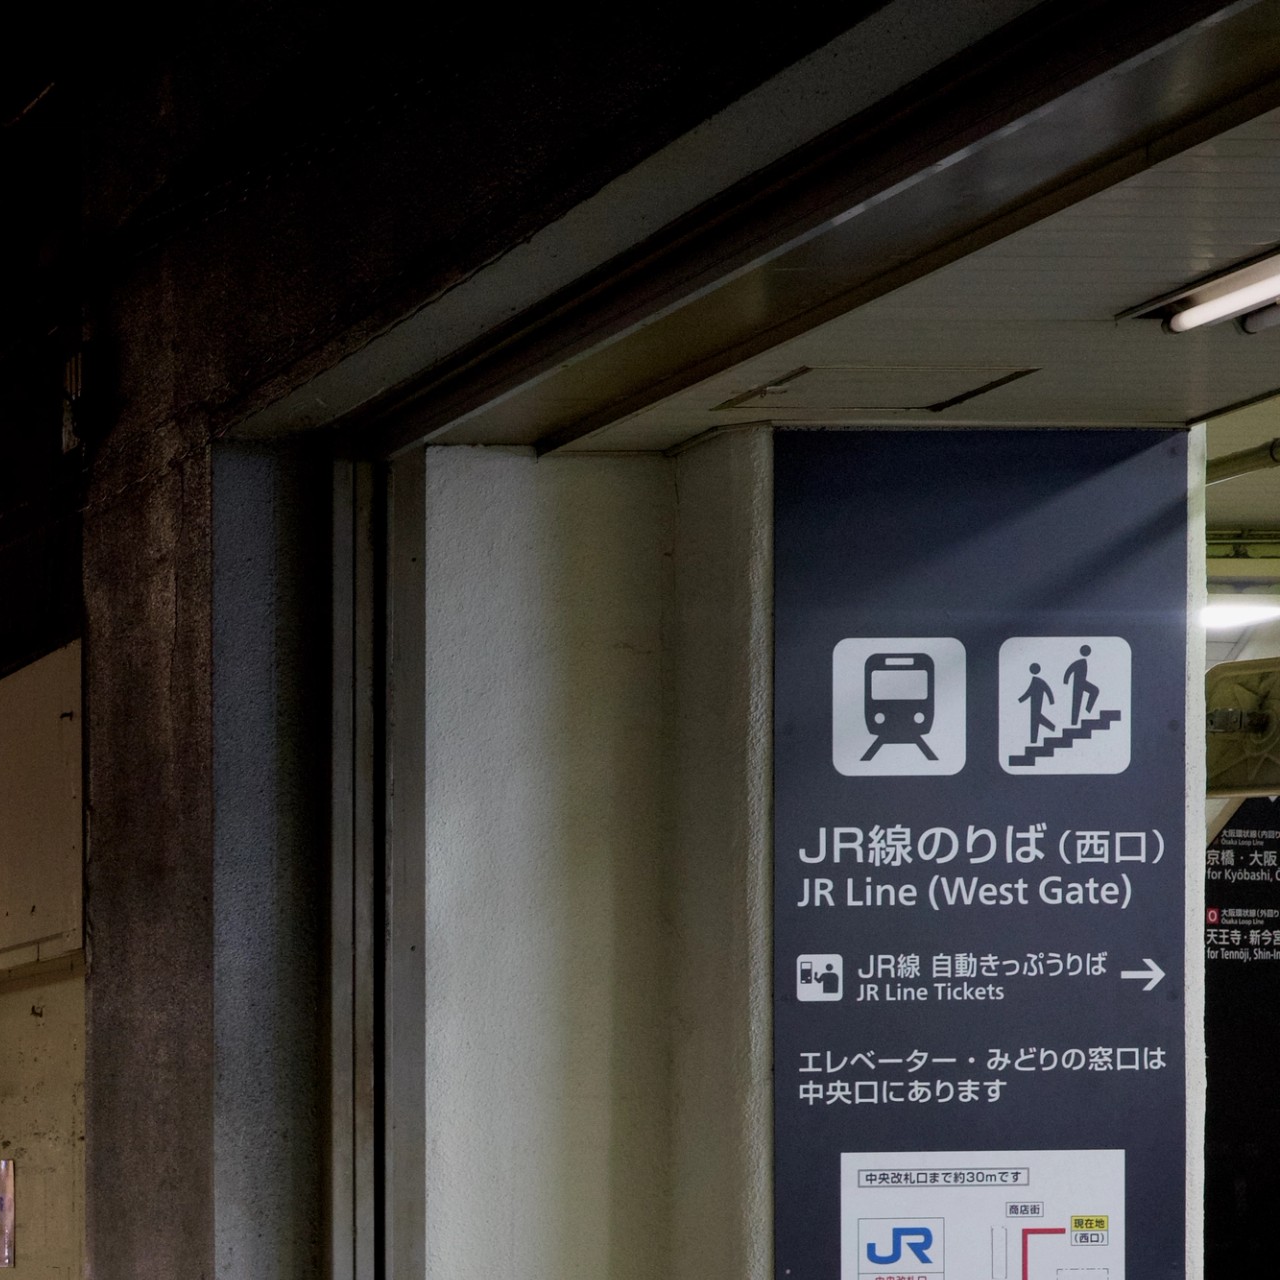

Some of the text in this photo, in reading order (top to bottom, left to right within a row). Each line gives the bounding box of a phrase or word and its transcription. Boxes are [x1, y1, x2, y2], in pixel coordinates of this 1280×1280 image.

[1207, 868, 1222, 880] for
[797, 873, 1132, 910] JR Line (West Gate)
[1207, 947, 1219, 959] for
[857, 951, 1107, 978] JR線 自動きっぷうりば
[857, 983, 1004, 1002] JR Line Tickets
[798, 1047, 1167, 1073] エレベーター・みどりの窓口は
[798, 1078, 1007, 1105] 中央口にあります
[865, 1171, 1022, 1184] 中央改札口まで約30mです
[1008, 1204, 1041, 1216] 商店街
[1073, 1217, 1106, 1230] 現在地
[866, 1227, 933, 1265] JR
[1074, 1232, 1105, 1244] (西口)
